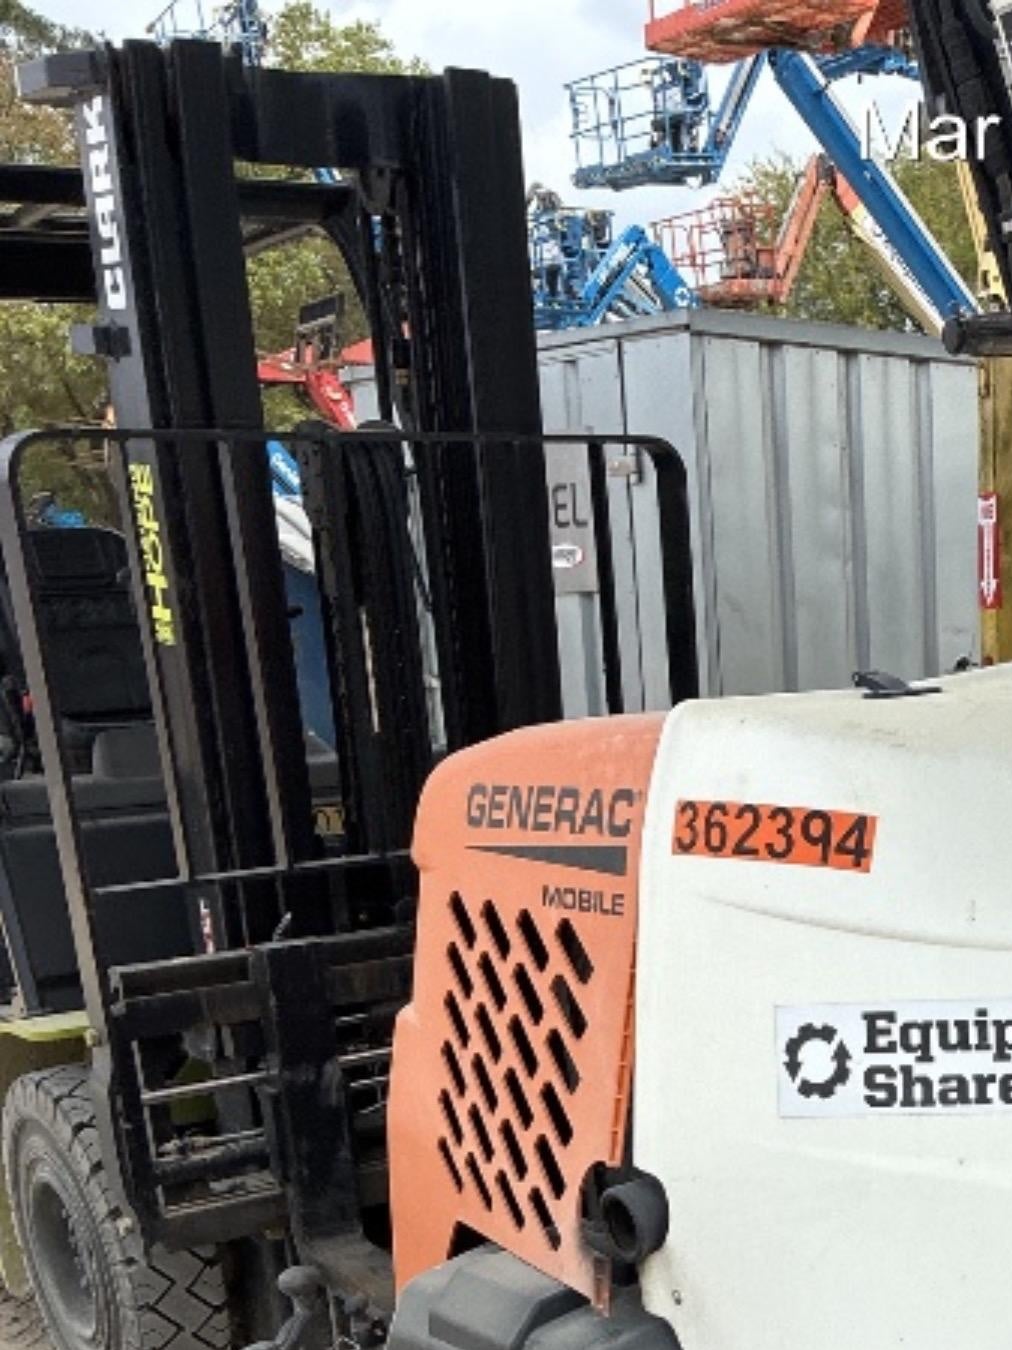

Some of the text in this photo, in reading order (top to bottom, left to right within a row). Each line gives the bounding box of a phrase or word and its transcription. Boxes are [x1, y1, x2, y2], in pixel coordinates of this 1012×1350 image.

[83, 95, 128, 311] CLARK
[466, 782, 634, 838] GENERAC
[676, 800, 872, 869] 362394
[542, 884, 626, 916] MOBILE
